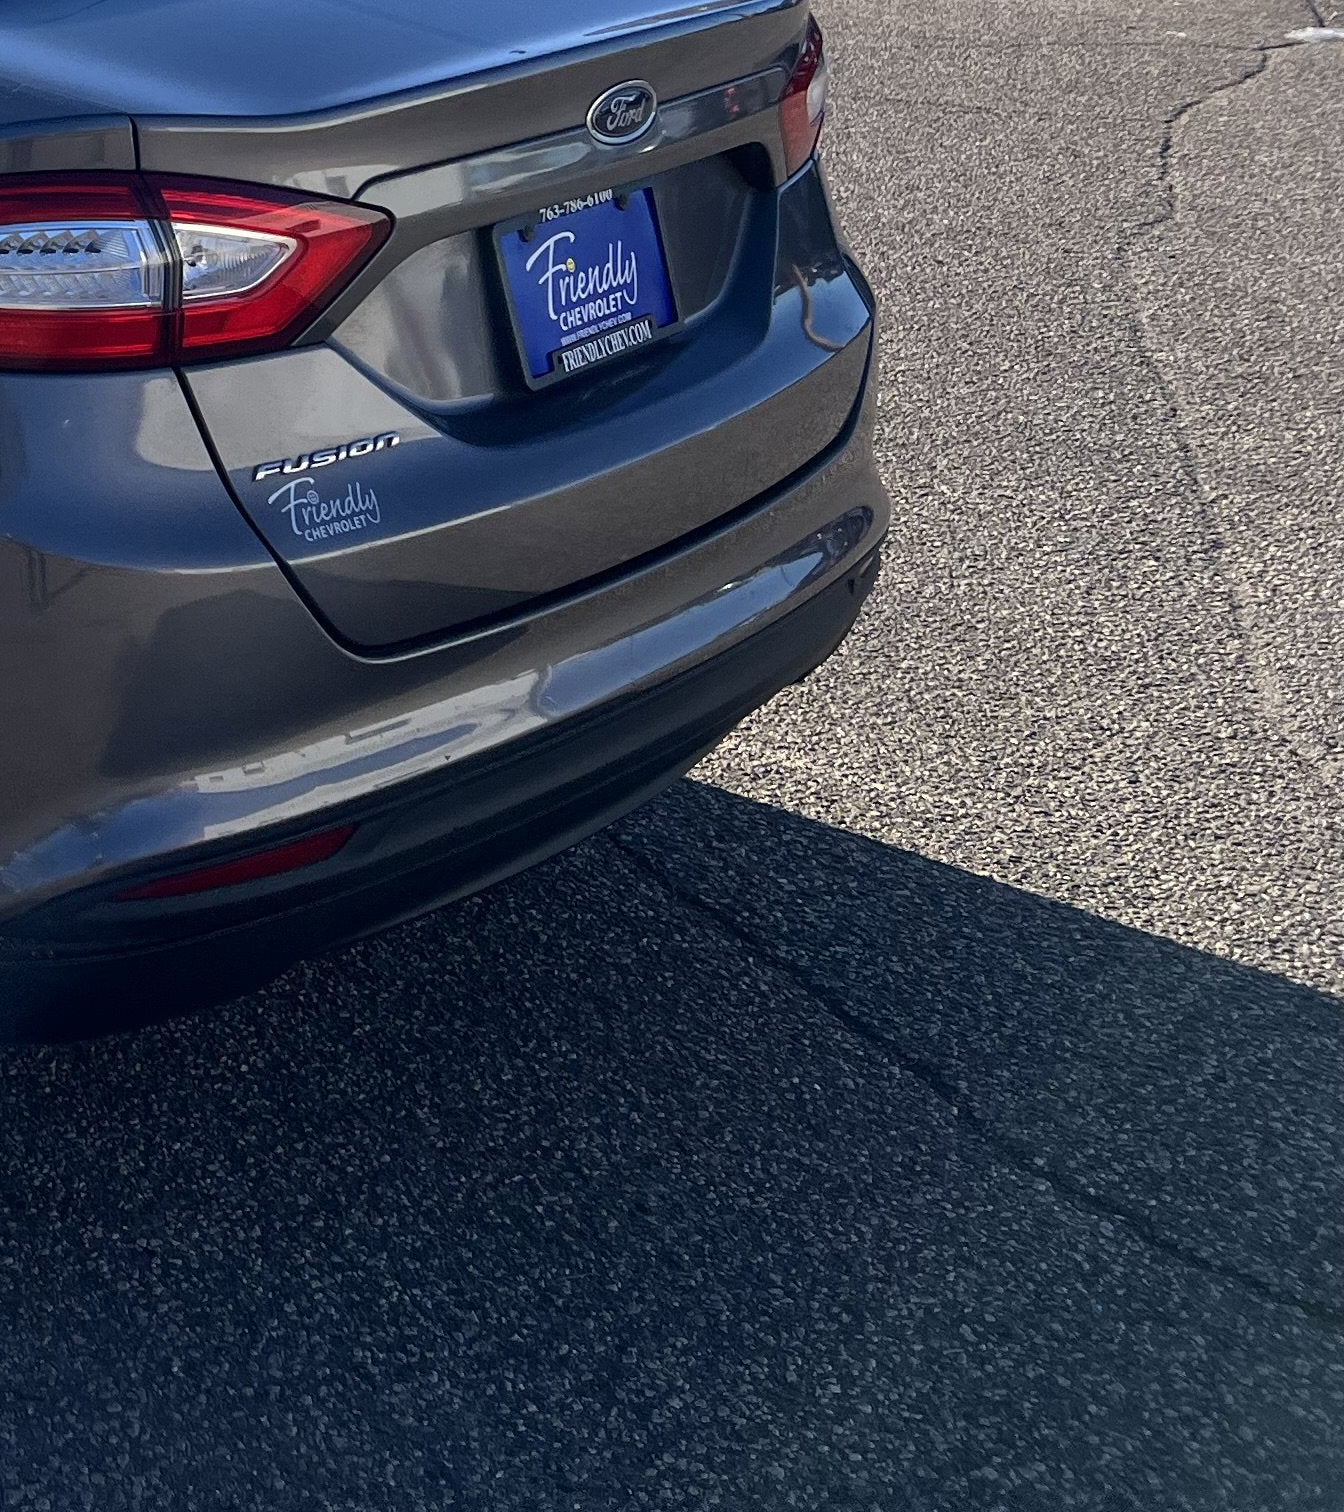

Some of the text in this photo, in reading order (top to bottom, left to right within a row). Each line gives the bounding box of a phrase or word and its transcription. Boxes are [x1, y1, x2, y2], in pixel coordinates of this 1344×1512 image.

[606, 94, 646, 131] Ford
[538, 188, 613, 223] 763-786-6100
[525, 231, 638, 321] Friendly
[559, 290, 623, 331] CHEVROLET
[561, 319, 653, 373] FRIENDLYCHEV.COM
[252, 430, 401, 481] FUSION
[267, 477, 381, 536] Friendly
[304, 514, 368, 542] CHEVROLET
